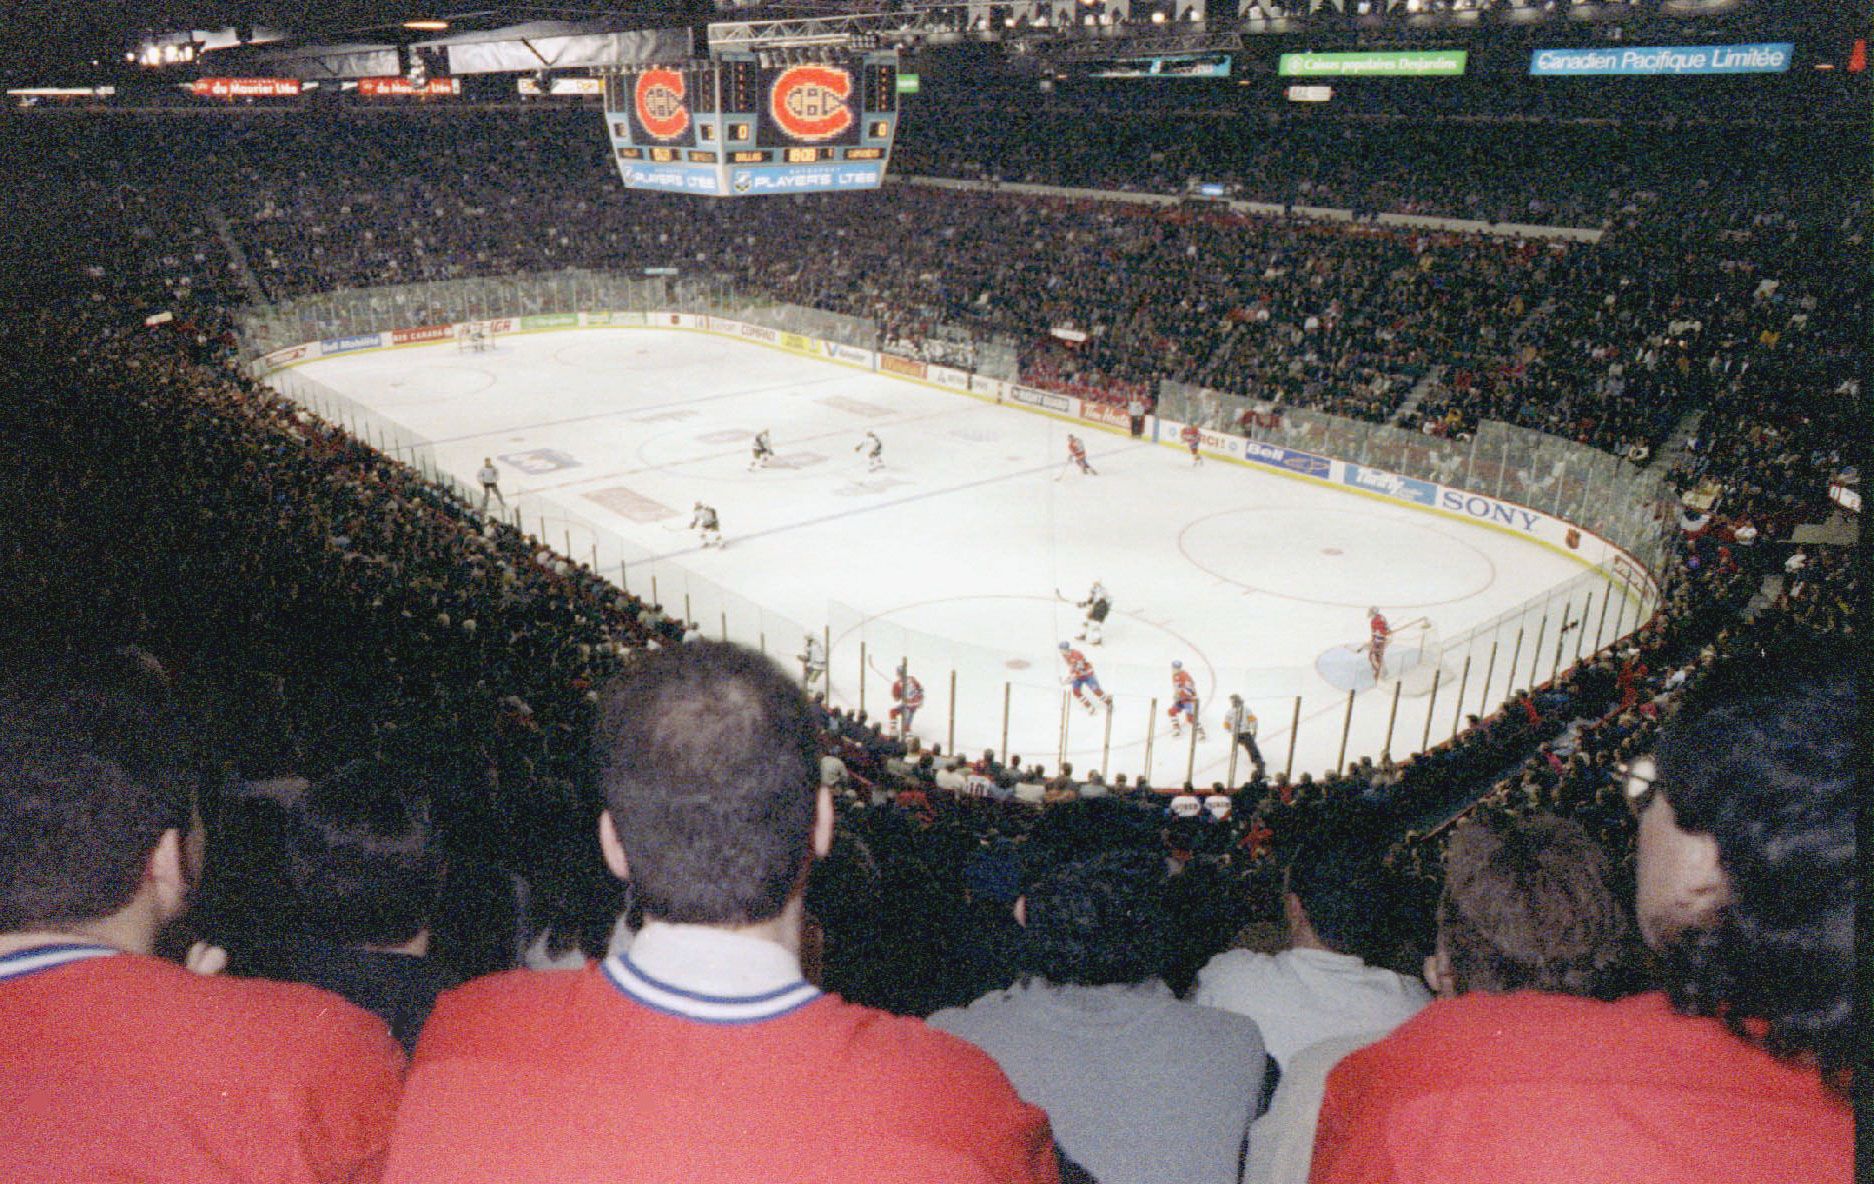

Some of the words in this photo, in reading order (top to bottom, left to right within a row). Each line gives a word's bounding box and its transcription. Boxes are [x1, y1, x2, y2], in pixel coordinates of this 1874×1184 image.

[1304, 57, 1340, 70] Caisses
[1341, 57, 1397, 74] populaires
[1399, 56, 1458, 74] Desjardins
[1537, 52, 1616, 70] Canadien
[1621, 50, 1706, 73] Pacifique
[1711, 46, 1784, 68] Limitée
[1441, 490, 1542, 532] SONY
